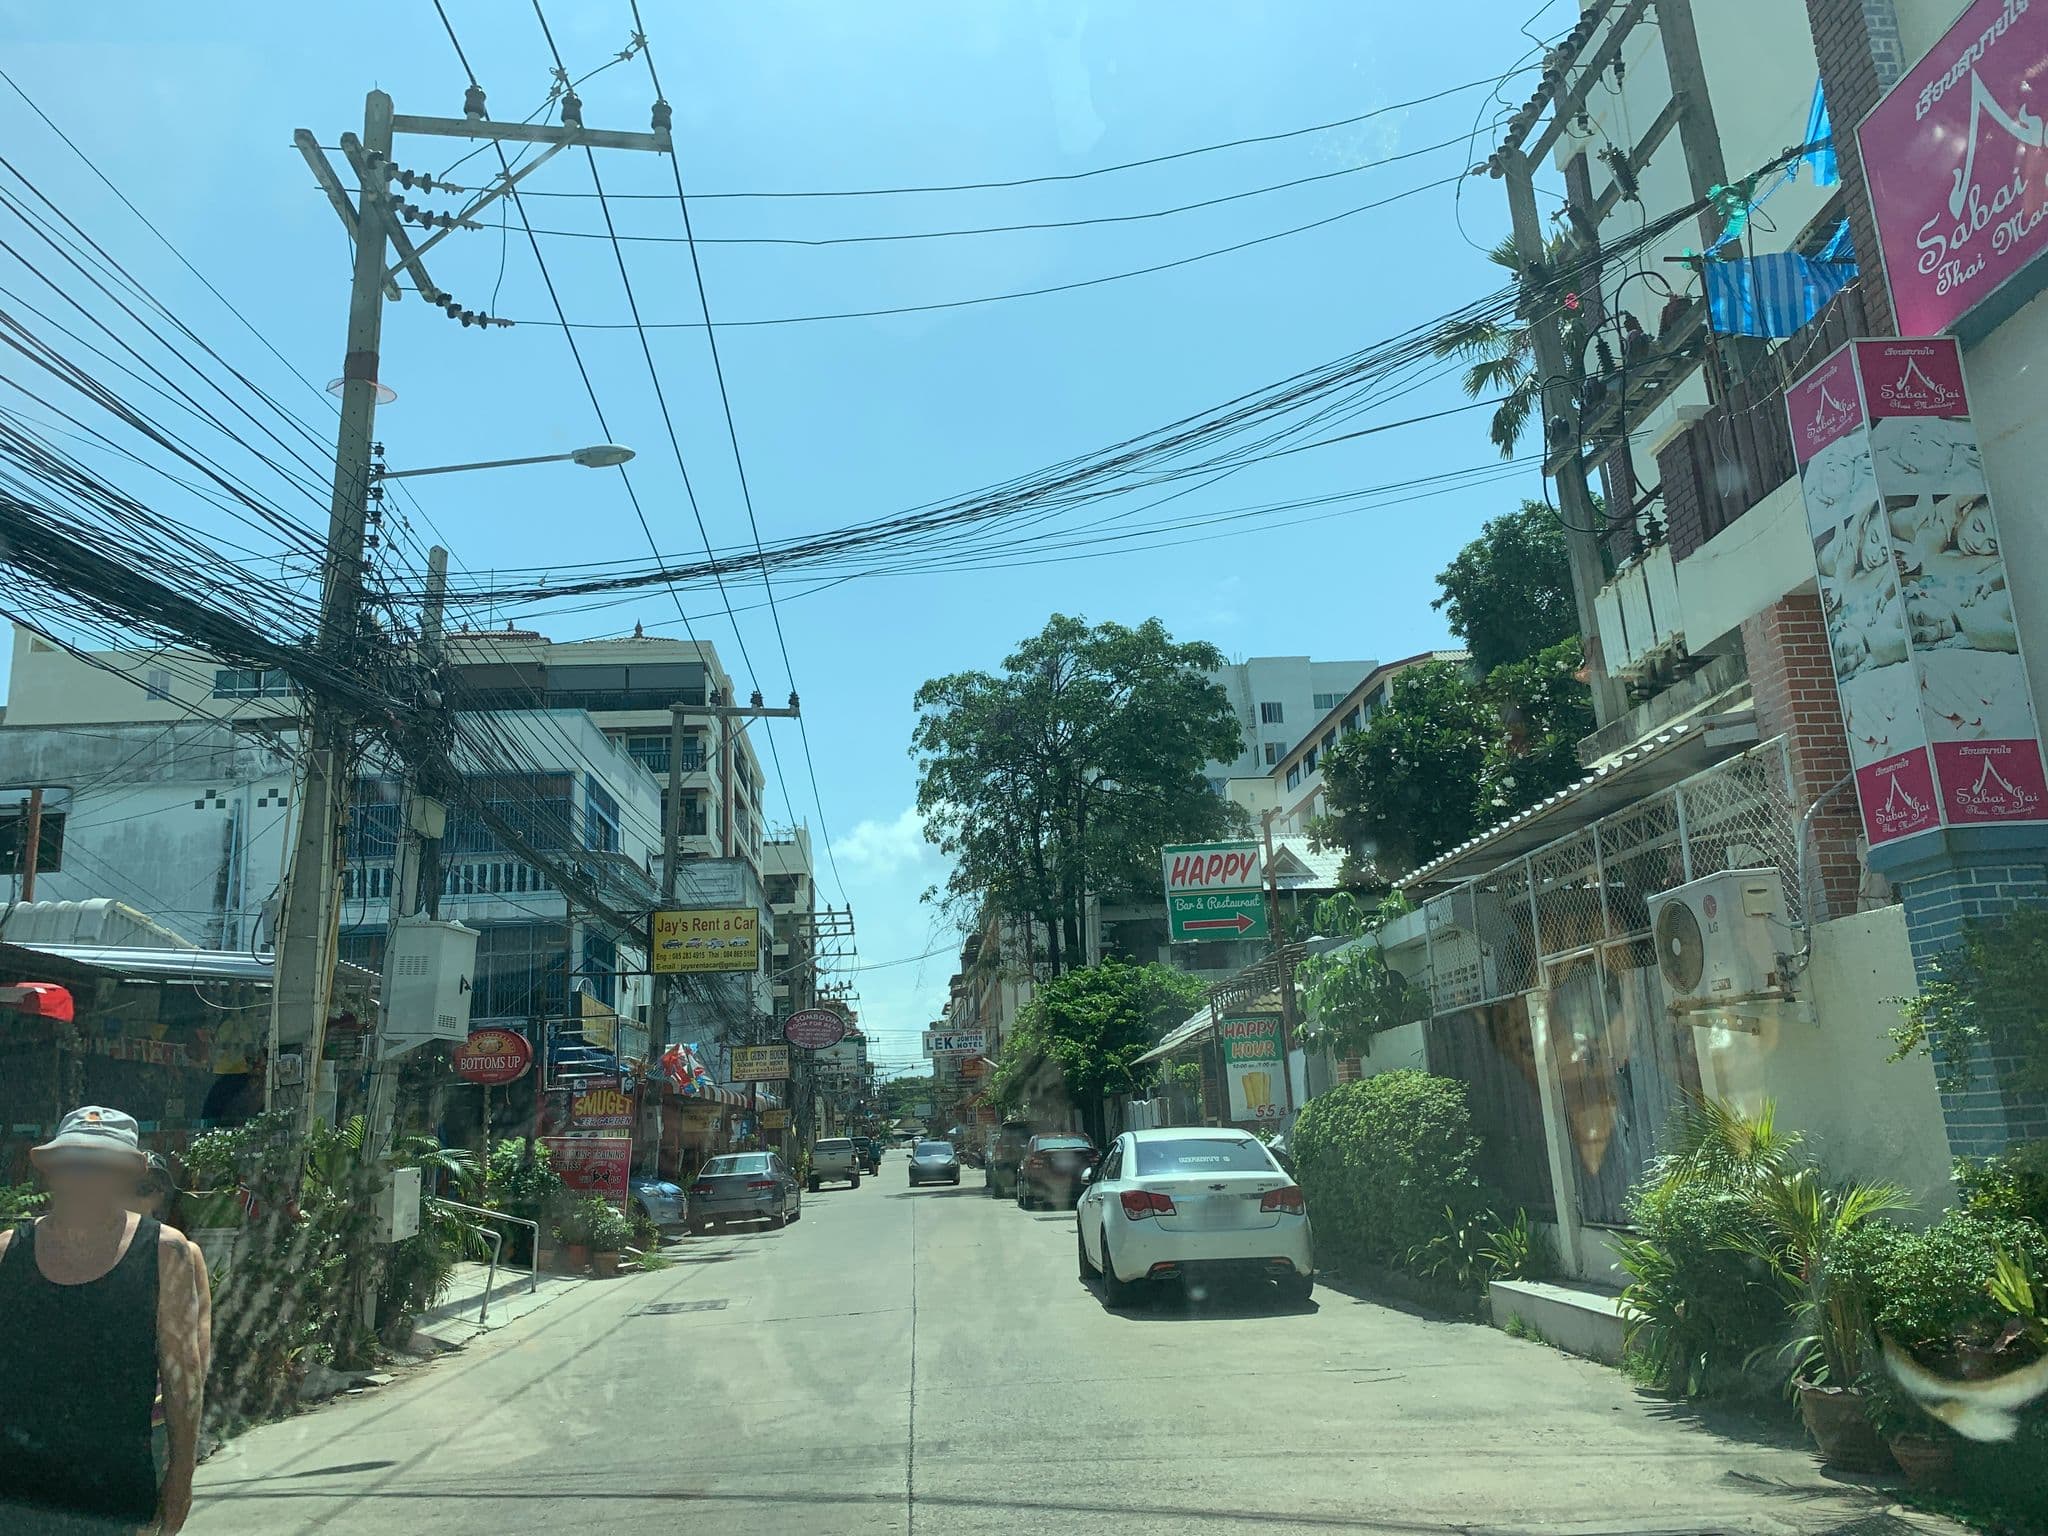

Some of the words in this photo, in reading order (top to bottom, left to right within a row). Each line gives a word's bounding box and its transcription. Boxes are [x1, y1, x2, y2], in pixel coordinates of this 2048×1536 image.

[1916, 166, 2028, 274] Sabai
[1936, 253, 1985, 295] Thai
[1880, 384, 1928, 399] Sabai
[1934, 386, 1960, 404] Jai
[1890, 400, 1910, 409] Thai
[1914, 400, 1956, 410] Massage
[1807, 414, 1836, 440] Sabai
[1840, 399, 1856, 424] Jai
[1956, 787, 2005, 804] Sabai
[2012, 786, 2040, 808] Jai
[1875, 806, 1908, 825] Sabai
[1911, 796, 1930, 821] Jai
[1966, 804, 1988, 816] Thai
[1992, 804, 2036, 816] Massage
[1171, 852, 1257, 887] HAPPY
[1174, 898, 1194, 911] Bar
[1196, 898, 1204, 910] &
[1207, 894, 1260, 910] Restaurant
[658, 918, 688, 936] Jay's
[692, 918, 720, 932] Rent
[724, 922, 730, 930] a
[734, 916, 755, 930] Car
[1708, 921, 1718, 934] LG
[794, 1014, 839, 1024] SOMBOON
[1224, 1020, 1277, 1039] HAPPY
[926, 1037, 953, 1050] LEK
[1231, 1040, 1276, 1058] HOUR
[460, 1056, 505, 1070] BOTTOMS
[508, 1056, 521, 1068] UP
[575, 1090, 632, 1116] SMUGET
[1256, 1104, 1275, 1117] 55
